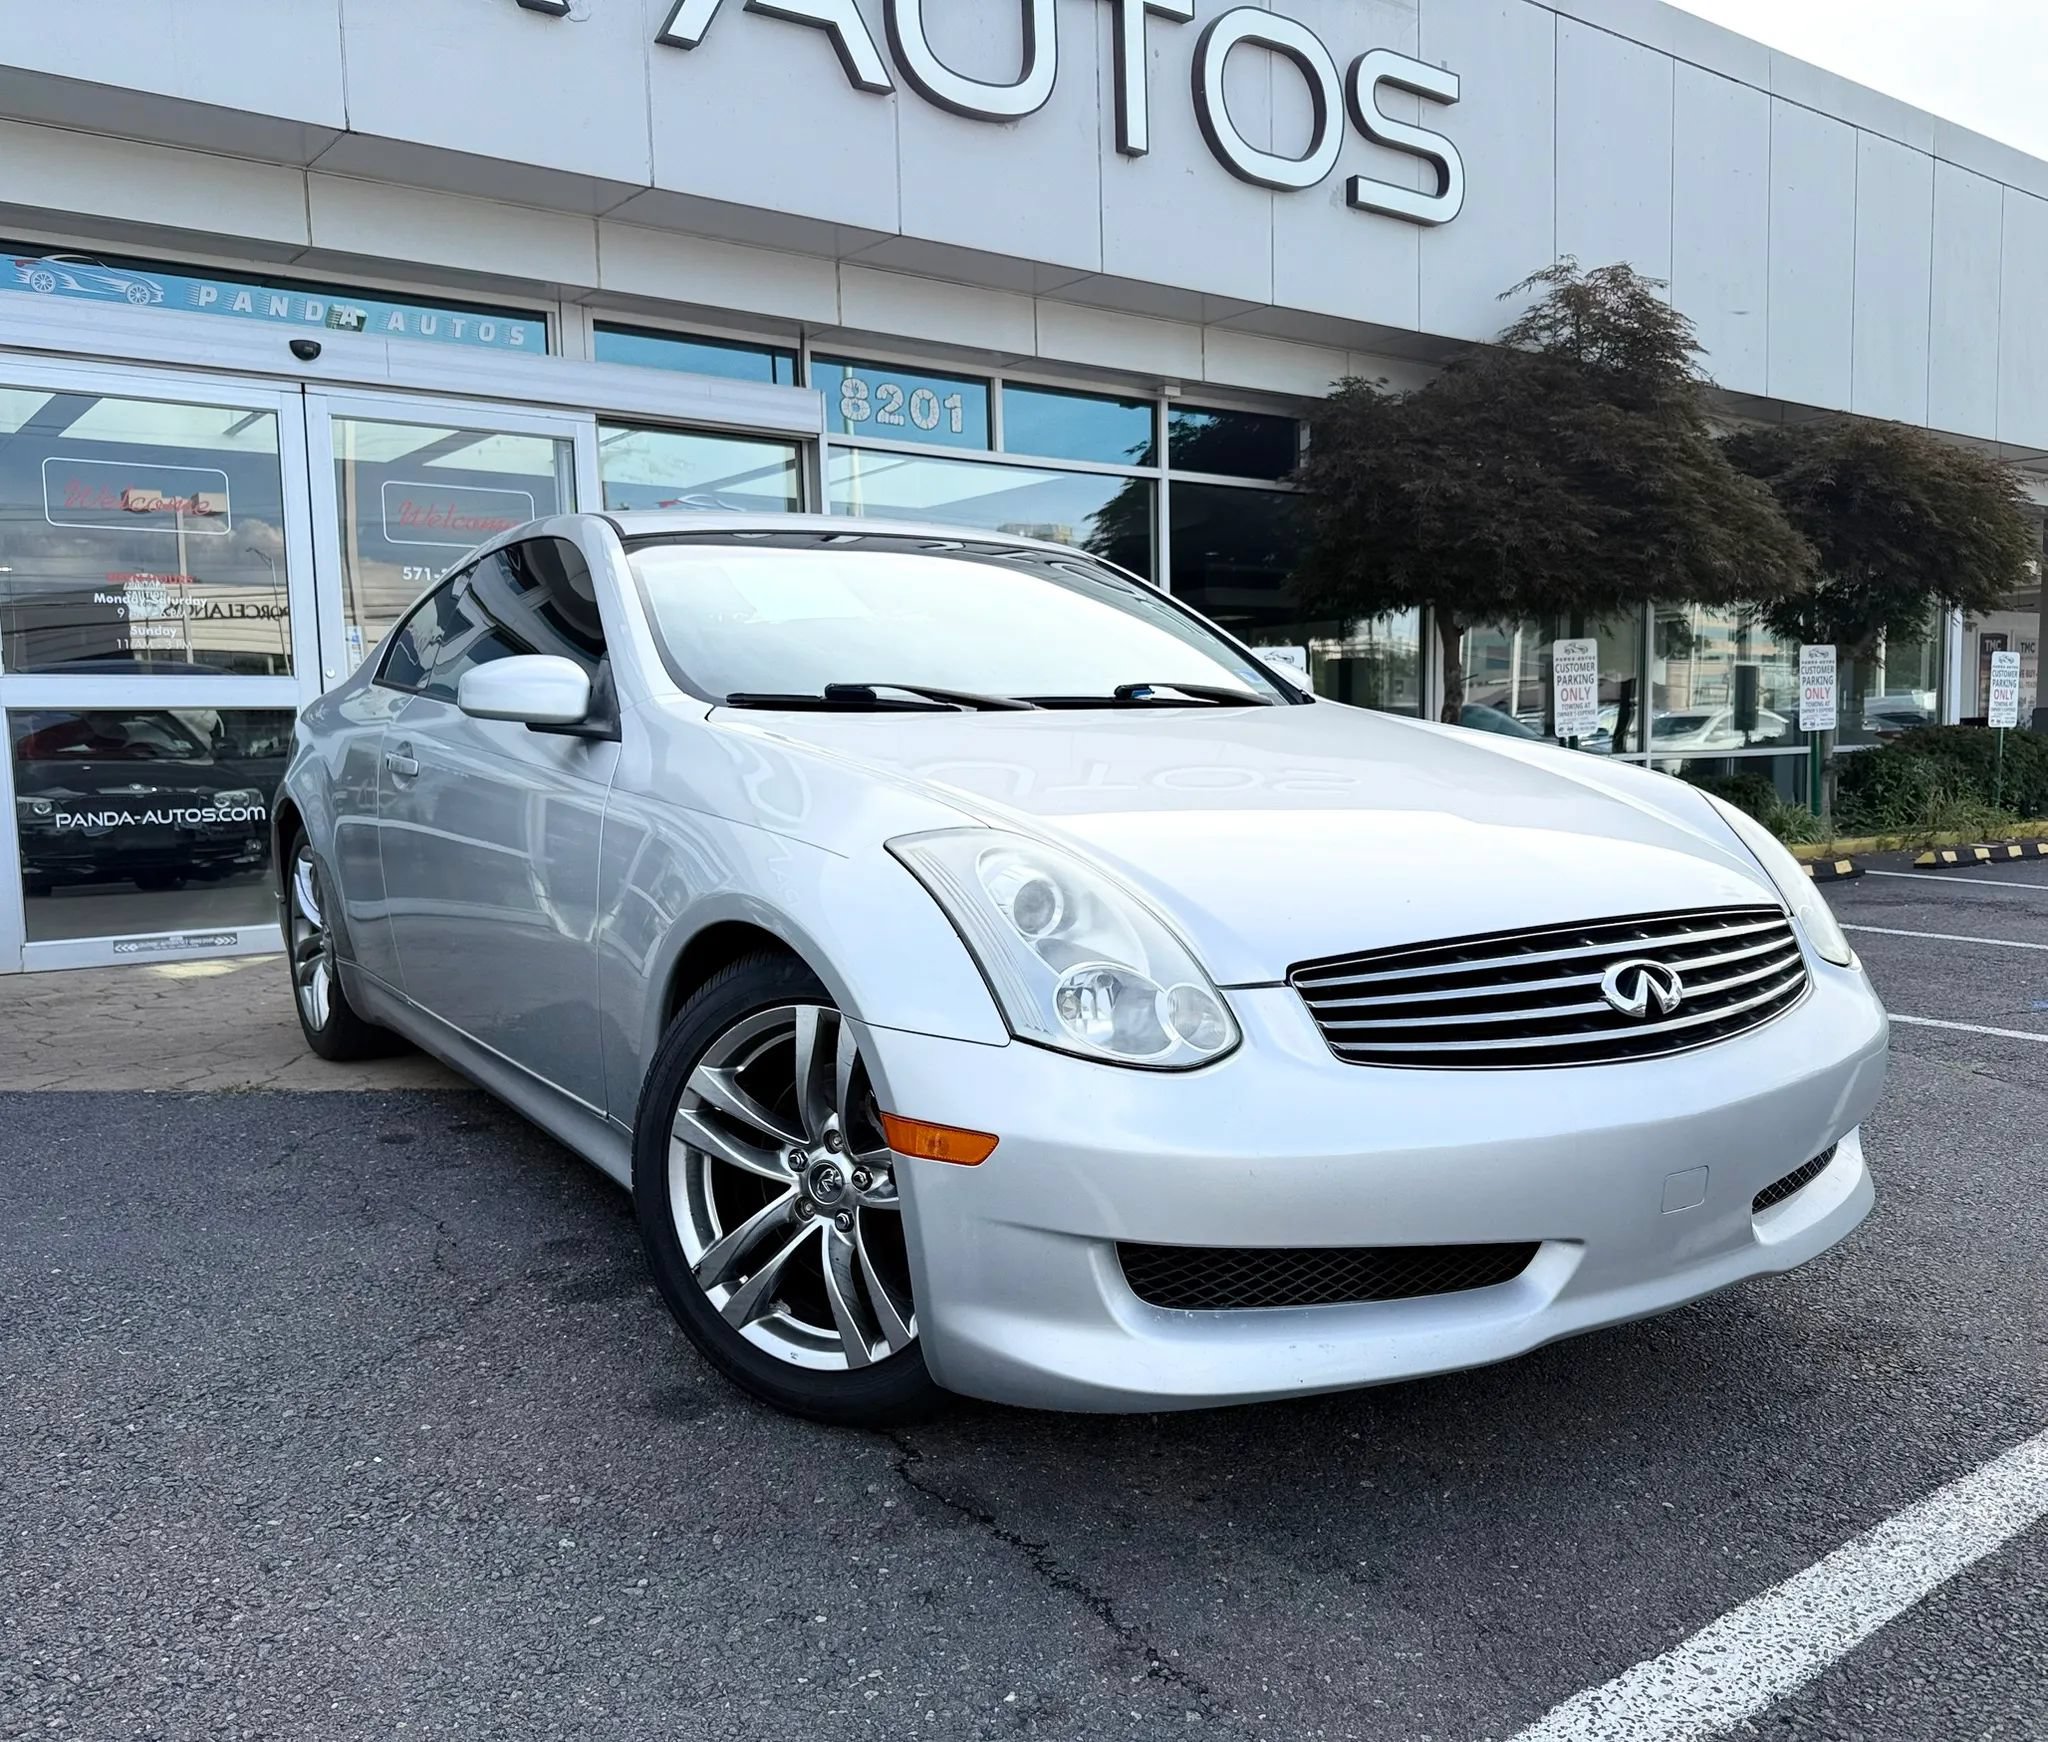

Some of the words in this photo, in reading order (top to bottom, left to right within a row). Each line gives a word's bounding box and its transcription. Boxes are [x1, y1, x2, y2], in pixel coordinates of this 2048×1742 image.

[198, 284, 359, 327] PANDA
[386, 311, 525, 346] AUTOS
[840, 377, 963, 434] 8201
[63, 476, 212, 515] Welcome
[117, 607, 125, 619] 9
[130, 625, 177, 639] Sunday
[116, 639, 129, 649] 11
[135, 639, 153, 649] AM
[1984, 639, 2002, 652] TMC
[2020, 642, 2036, 653] TMC
[1554, 662, 1595, 674] CUSTOMER
[1800, 665, 1835, 675] CUSTOMER
[1992, 669, 2018, 678] CUSTOMER
[1556, 673, 1595, 686] PARKING
[1802, 675, 1834, 686] PARKING
[1992, 679, 2017, 688] PARKING
[1560, 687, 1591, 702] ONLY
[1805, 687, 1831, 700] ONLY
[1993, 689, 2014, 700] ONLY
[1561, 703, 1584, 711] TOWING
